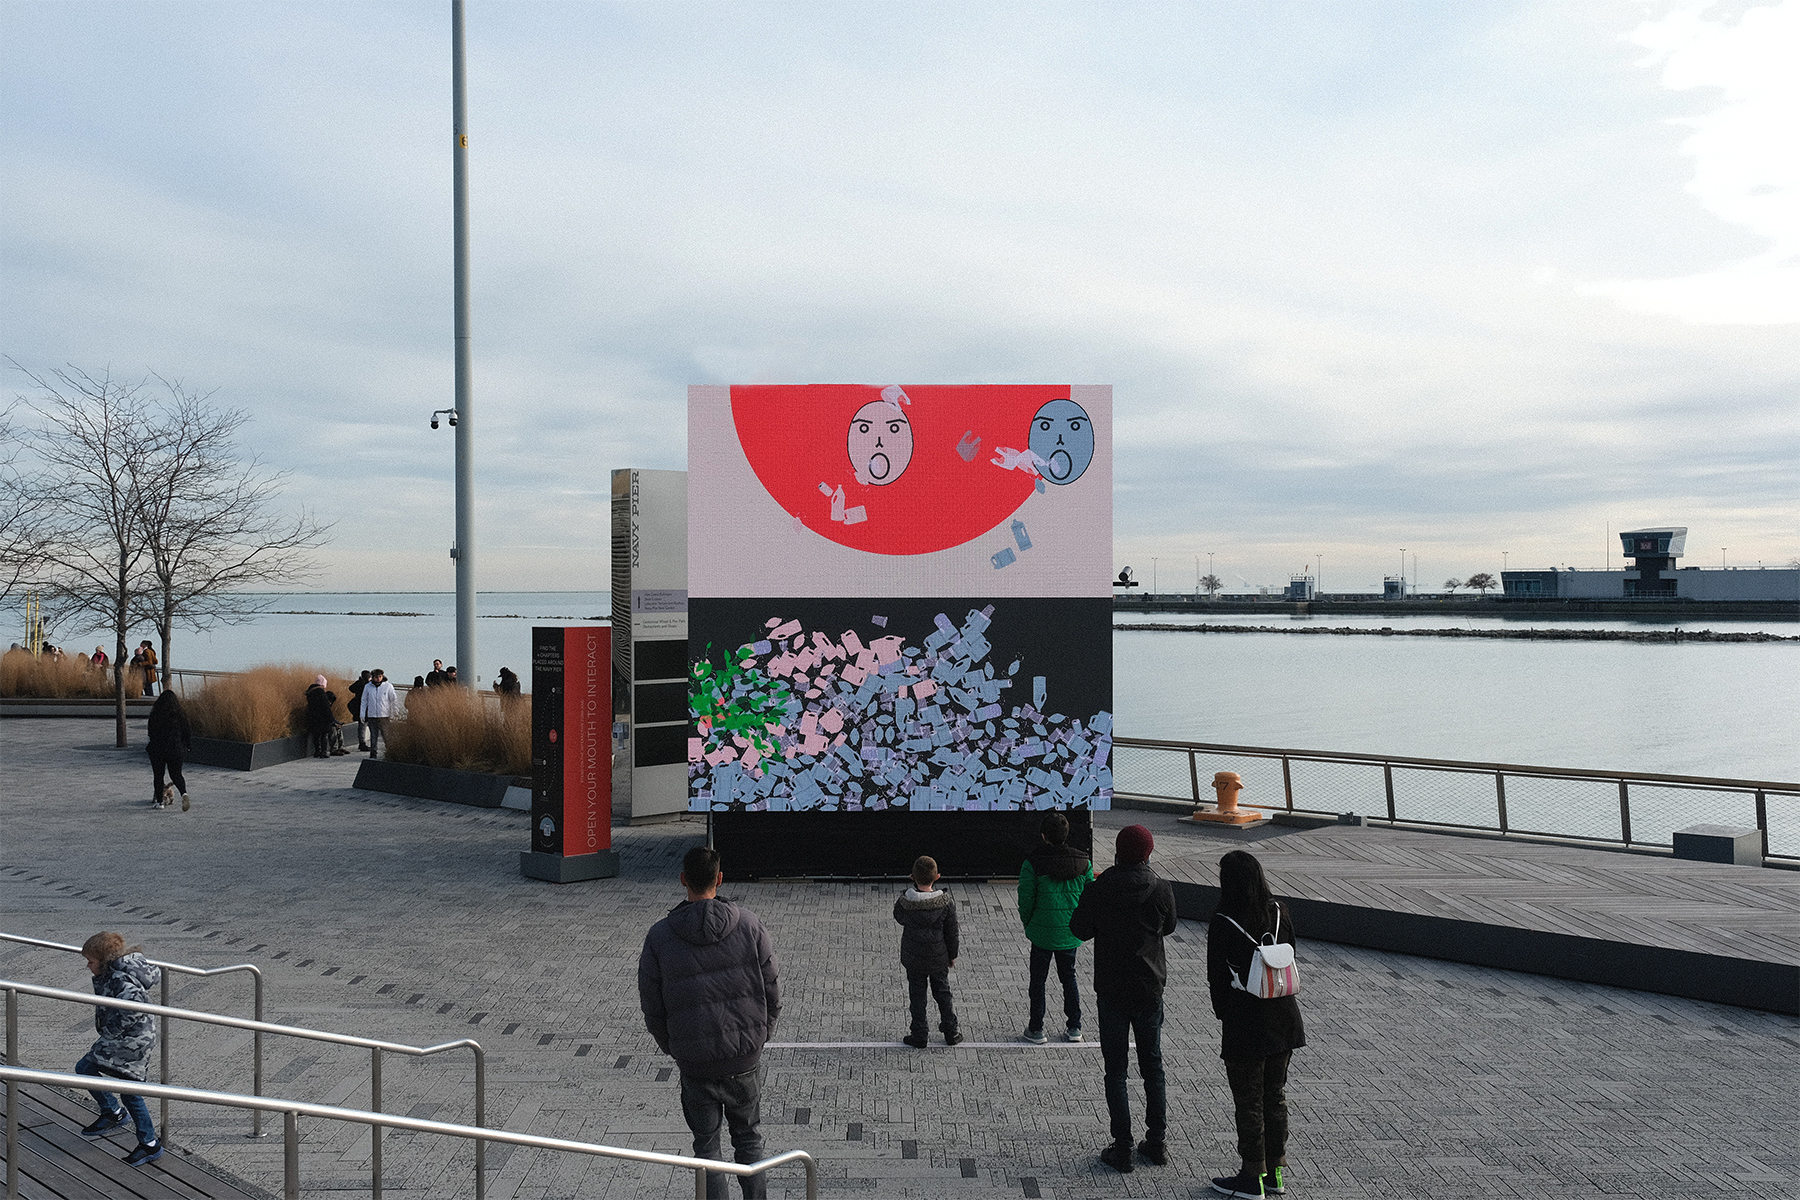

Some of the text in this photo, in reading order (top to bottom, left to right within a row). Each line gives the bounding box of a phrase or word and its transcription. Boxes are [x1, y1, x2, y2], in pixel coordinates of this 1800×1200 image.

[587, 634, 596, 847] OPEN YOUR MOUTH TO INTERACT
